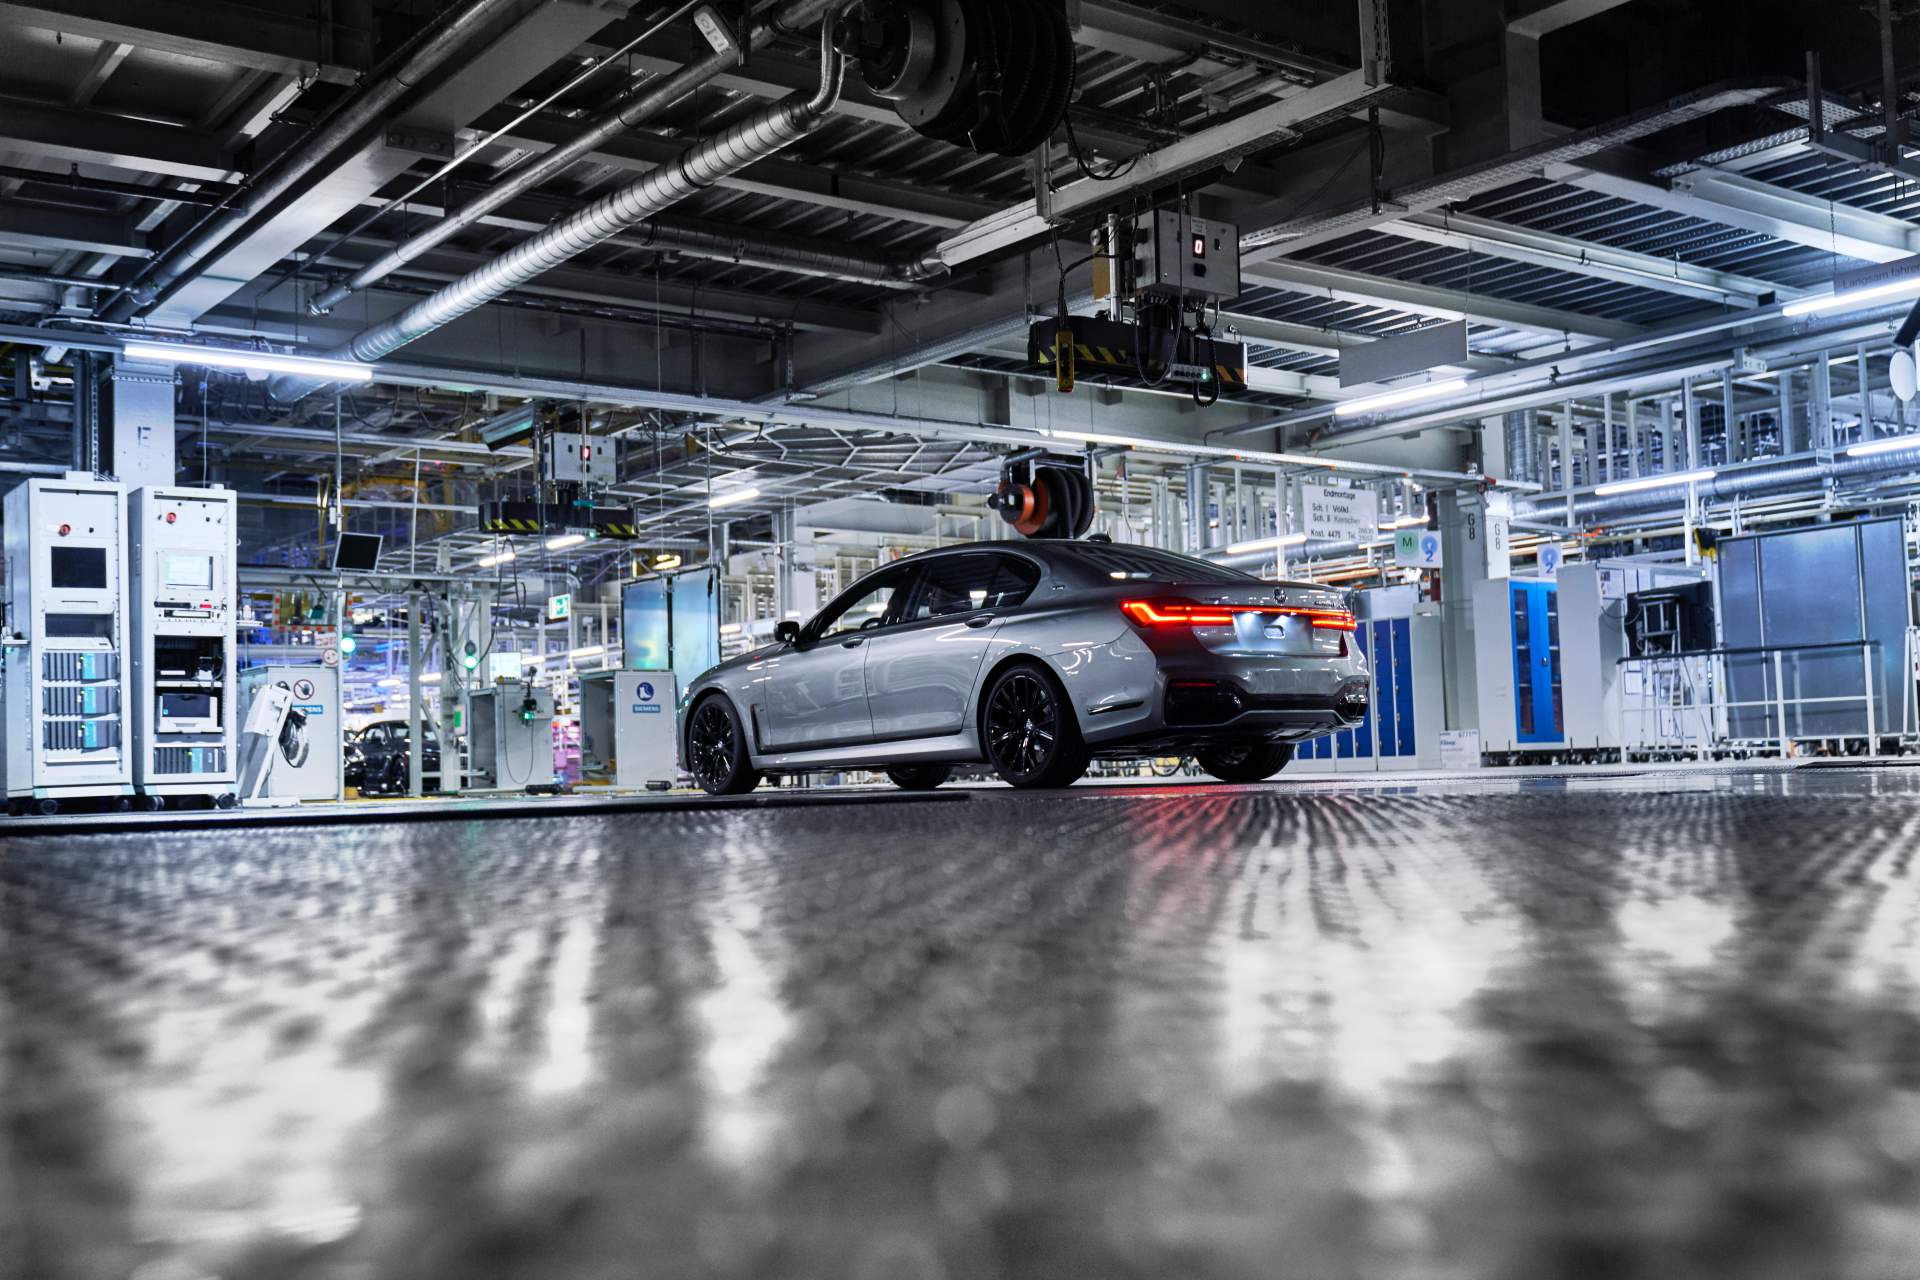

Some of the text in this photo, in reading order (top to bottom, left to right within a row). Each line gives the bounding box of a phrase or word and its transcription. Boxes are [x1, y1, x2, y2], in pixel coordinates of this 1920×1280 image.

[1194, 239, 1204, 255] 0
[1842, 271, 1889, 289] Langsam
[1323, 488, 1356, 501] Endmontage
[1402, 536, 1412, 548] M
[1425, 550, 1434, 562] 2
[1545, 561, 1554, 574] 2
